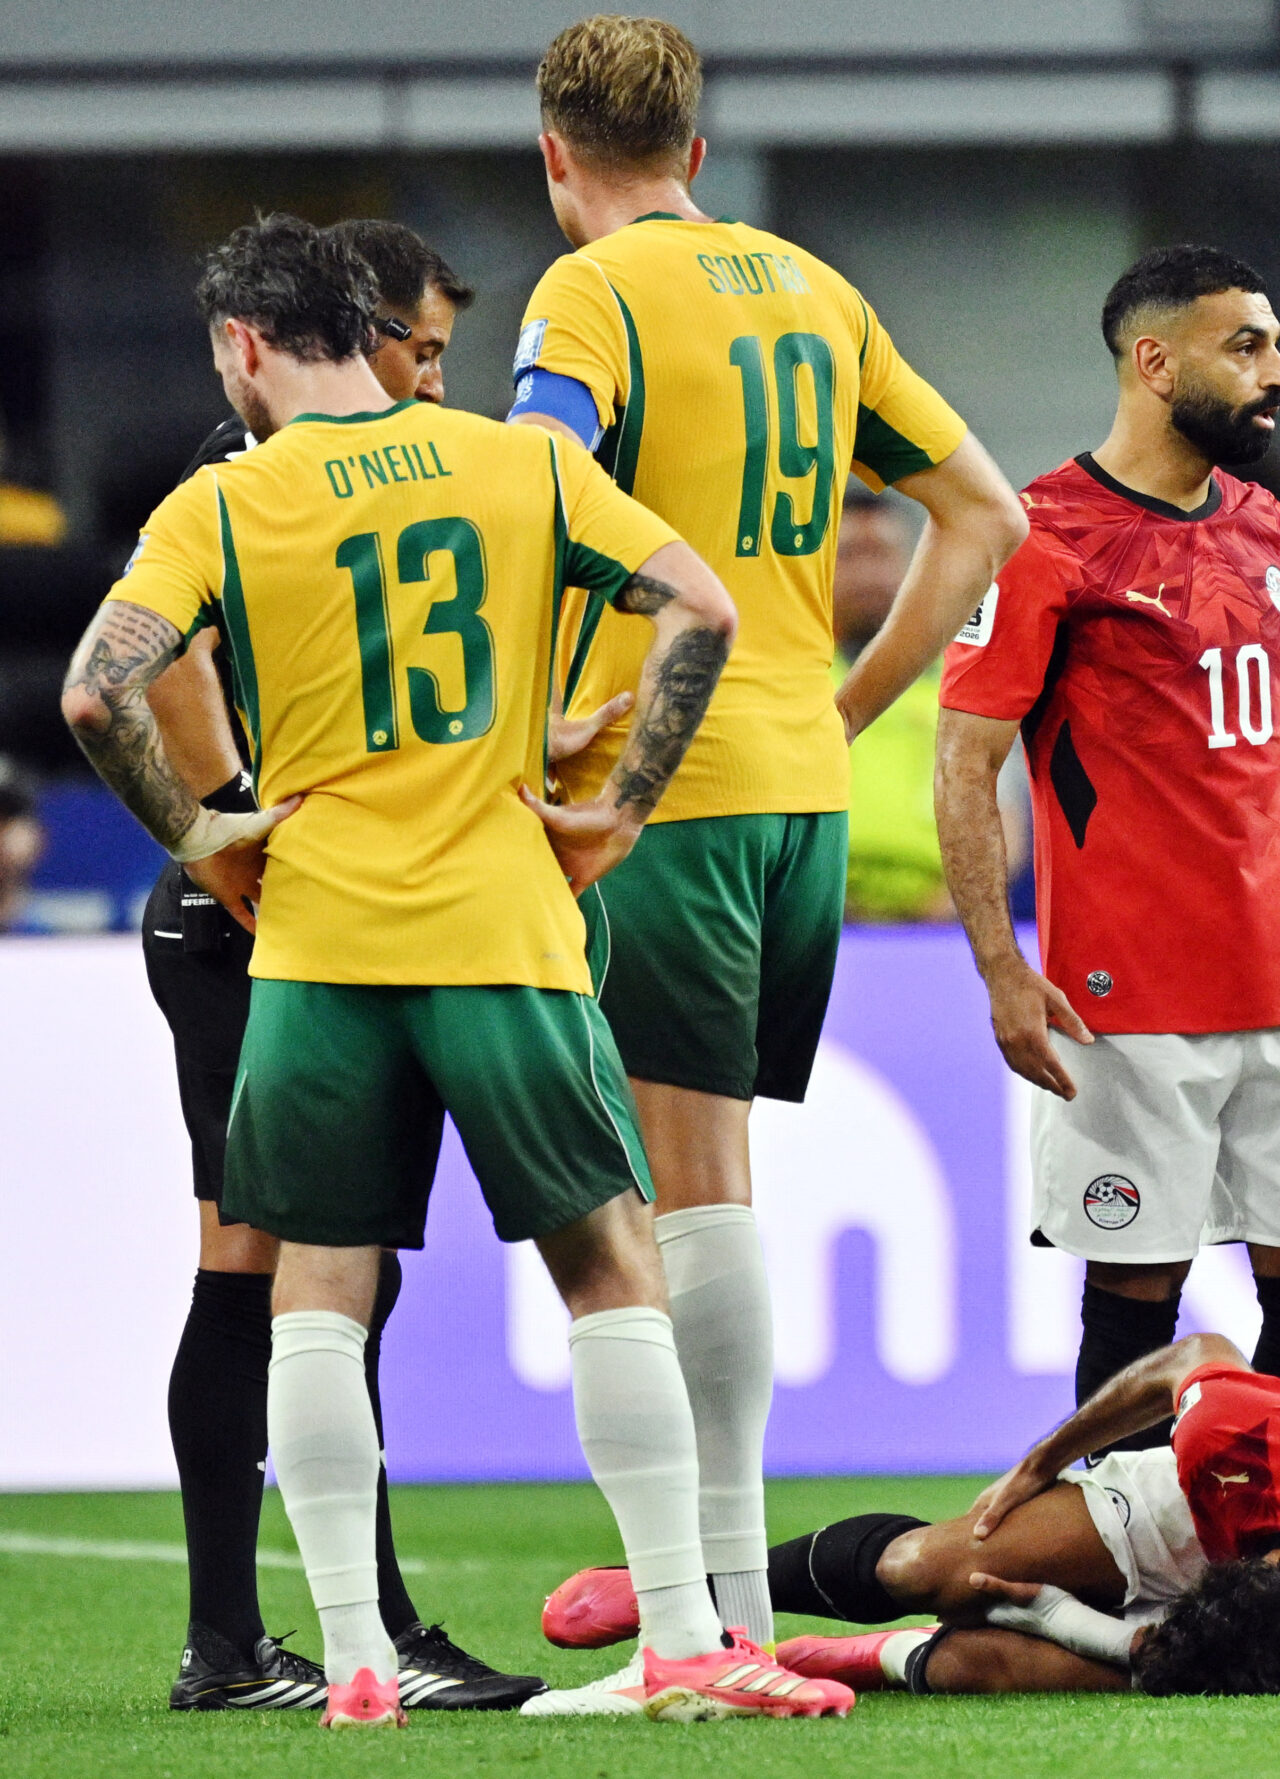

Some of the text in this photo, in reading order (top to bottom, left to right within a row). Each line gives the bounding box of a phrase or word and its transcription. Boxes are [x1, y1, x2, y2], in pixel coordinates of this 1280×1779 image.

[324, 441, 452, 498] O'NEILL
[729, 332, 836, 558] 19
[335, 516, 497, 753] 13
[959, 630, 981, 640] 2026
[1198, 643, 1274, 749] 10
